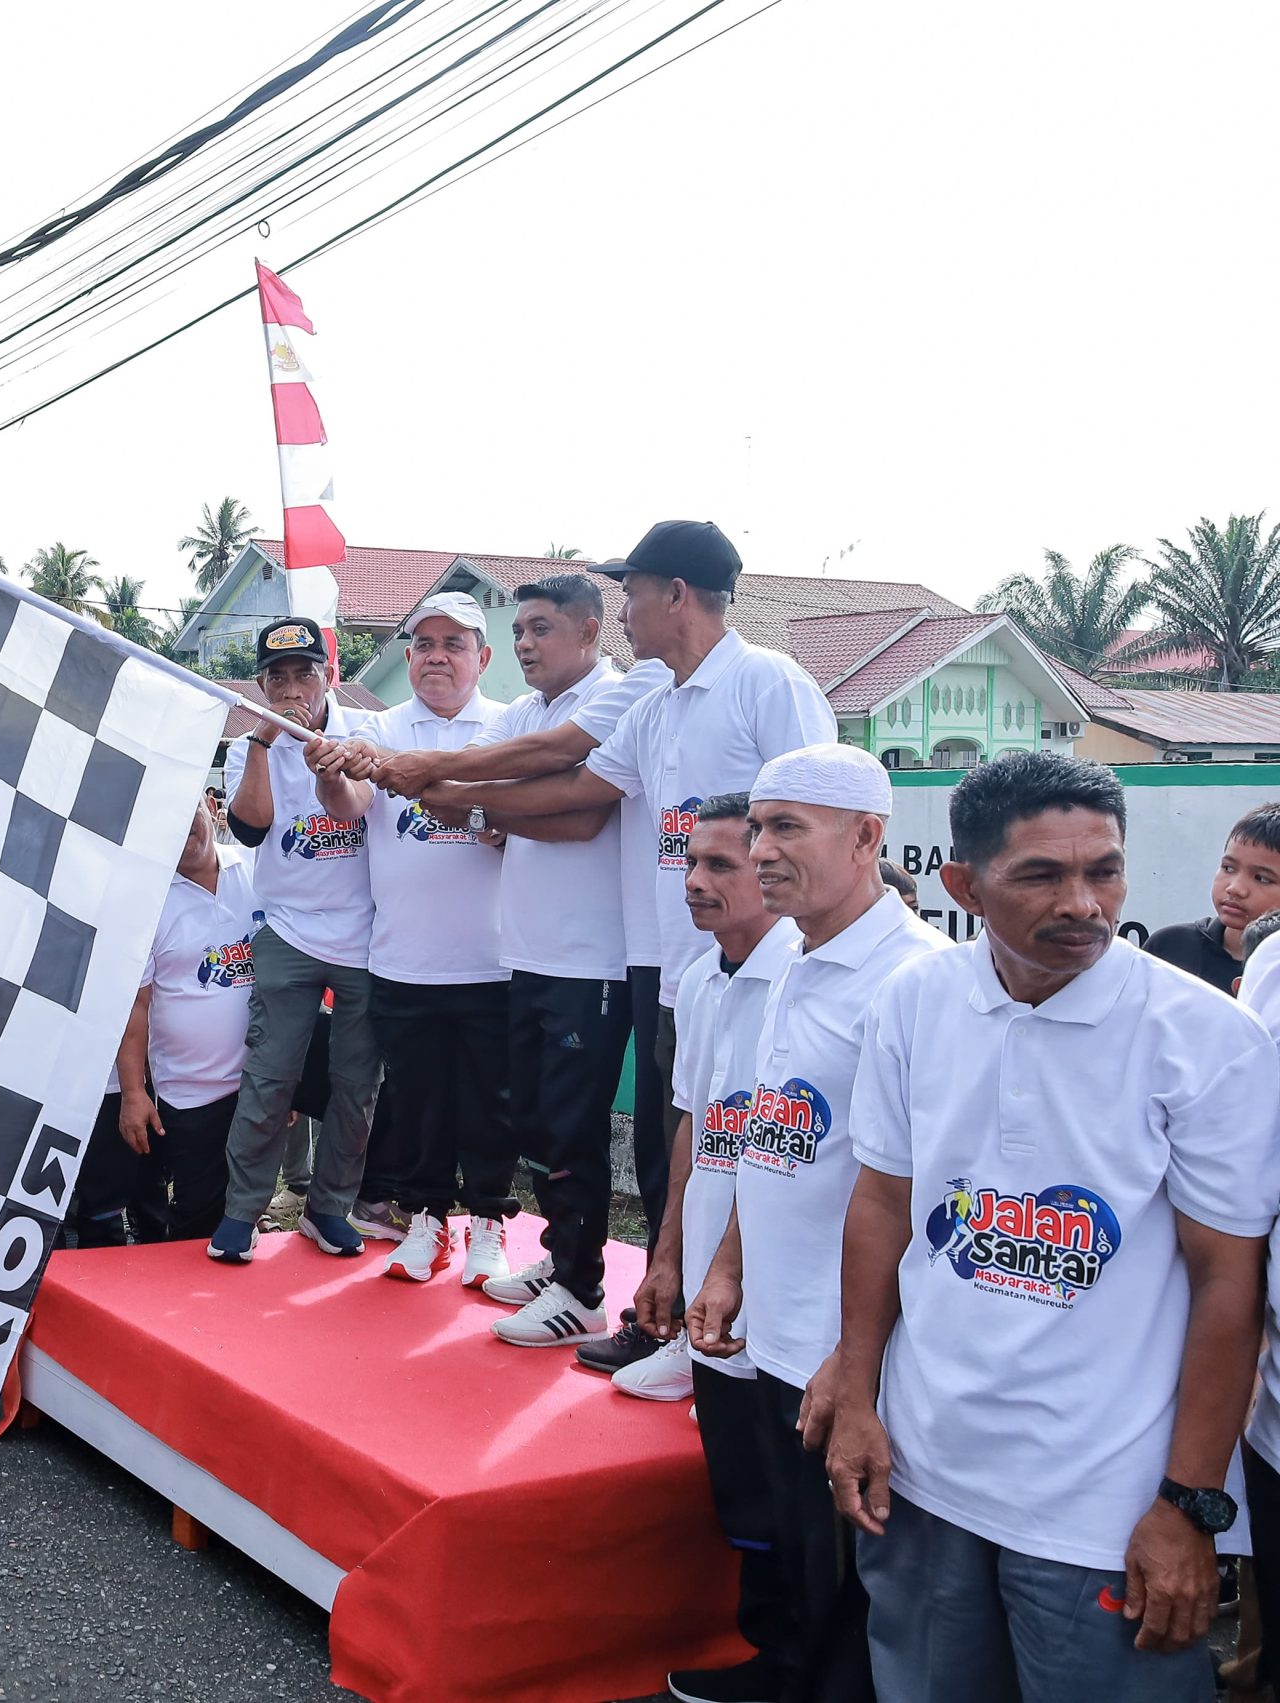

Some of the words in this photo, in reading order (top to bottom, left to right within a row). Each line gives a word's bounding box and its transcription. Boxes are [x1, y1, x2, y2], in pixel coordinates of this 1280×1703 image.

[311, 829, 363, 850] Santai
[221, 942, 253, 965] Jala
[225, 961, 255, 978] San
[750, 1086, 812, 1131] Jaan
[969, 1193, 1091, 1250] Jalan
[969, 1232, 1098, 1286] Santai
[974, 1281, 1026, 1302] Kecamatan
[1027, 1294, 1074, 1310] Meureubo
[975, 1269, 1052, 1296] Masyarakat
